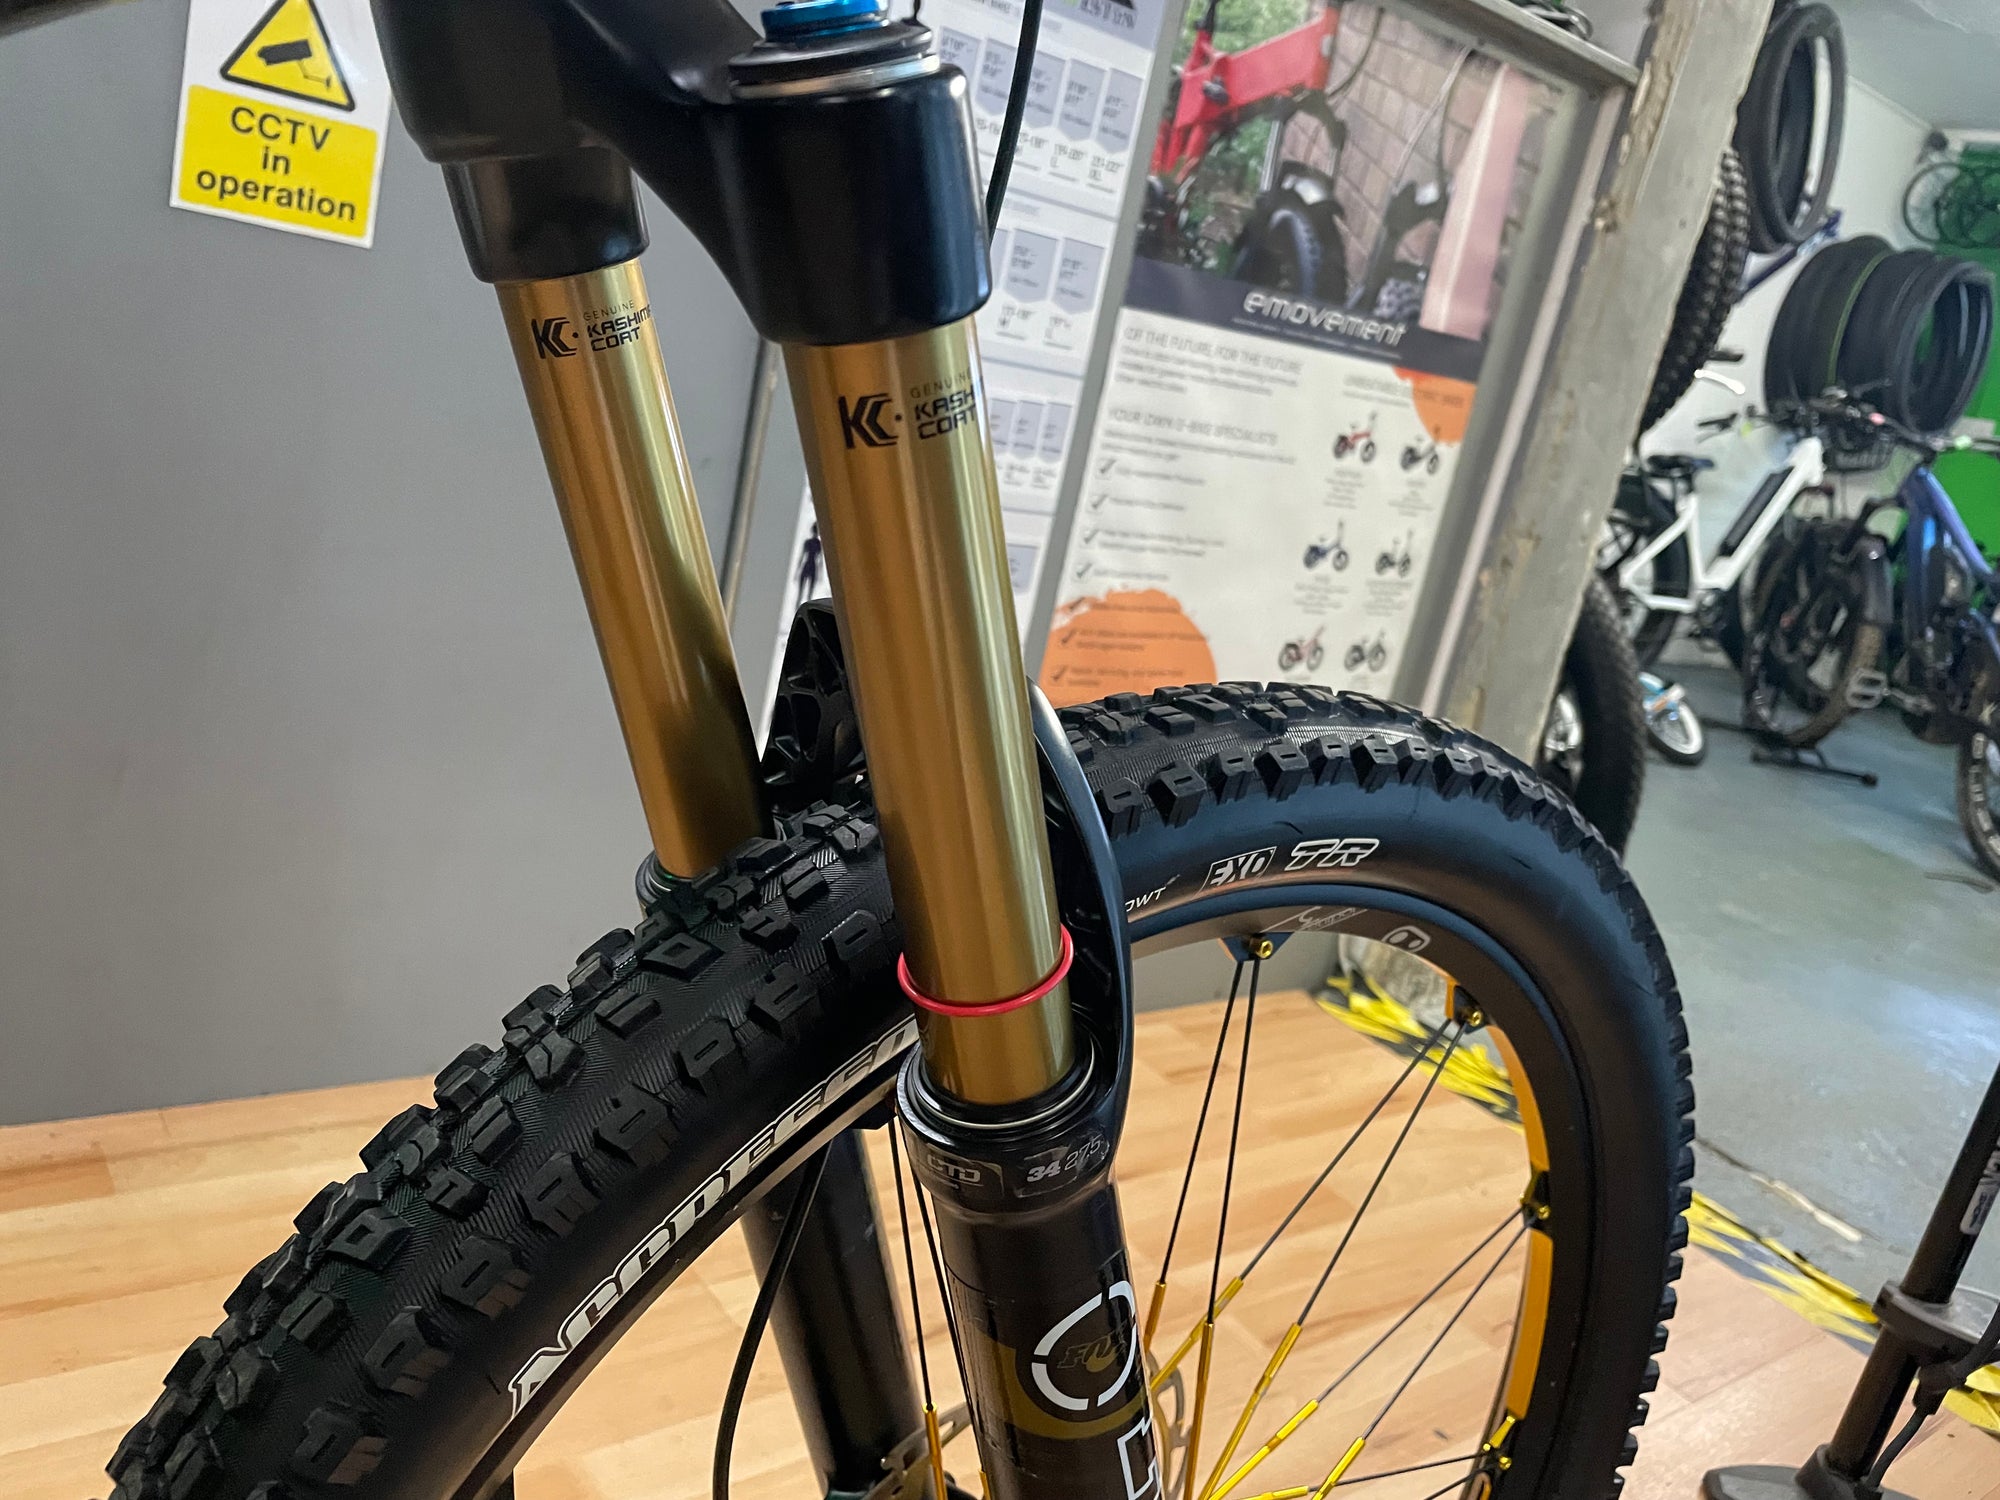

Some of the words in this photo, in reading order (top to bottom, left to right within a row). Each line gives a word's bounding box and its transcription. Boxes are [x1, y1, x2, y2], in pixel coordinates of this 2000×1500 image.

[231, 106, 330, 150] CCTV
[262, 146, 290, 174] in
[197, 170, 356, 221] operation
[583, 300, 635, 321] GENUINE
[591, 327, 640, 352] COAT
[918, 403, 977, 440] COAT
[1209, 849, 1274, 887] EXO
[1284, 838, 1380, 871] TR
[1026, 1159, 1061, 1182] 34
